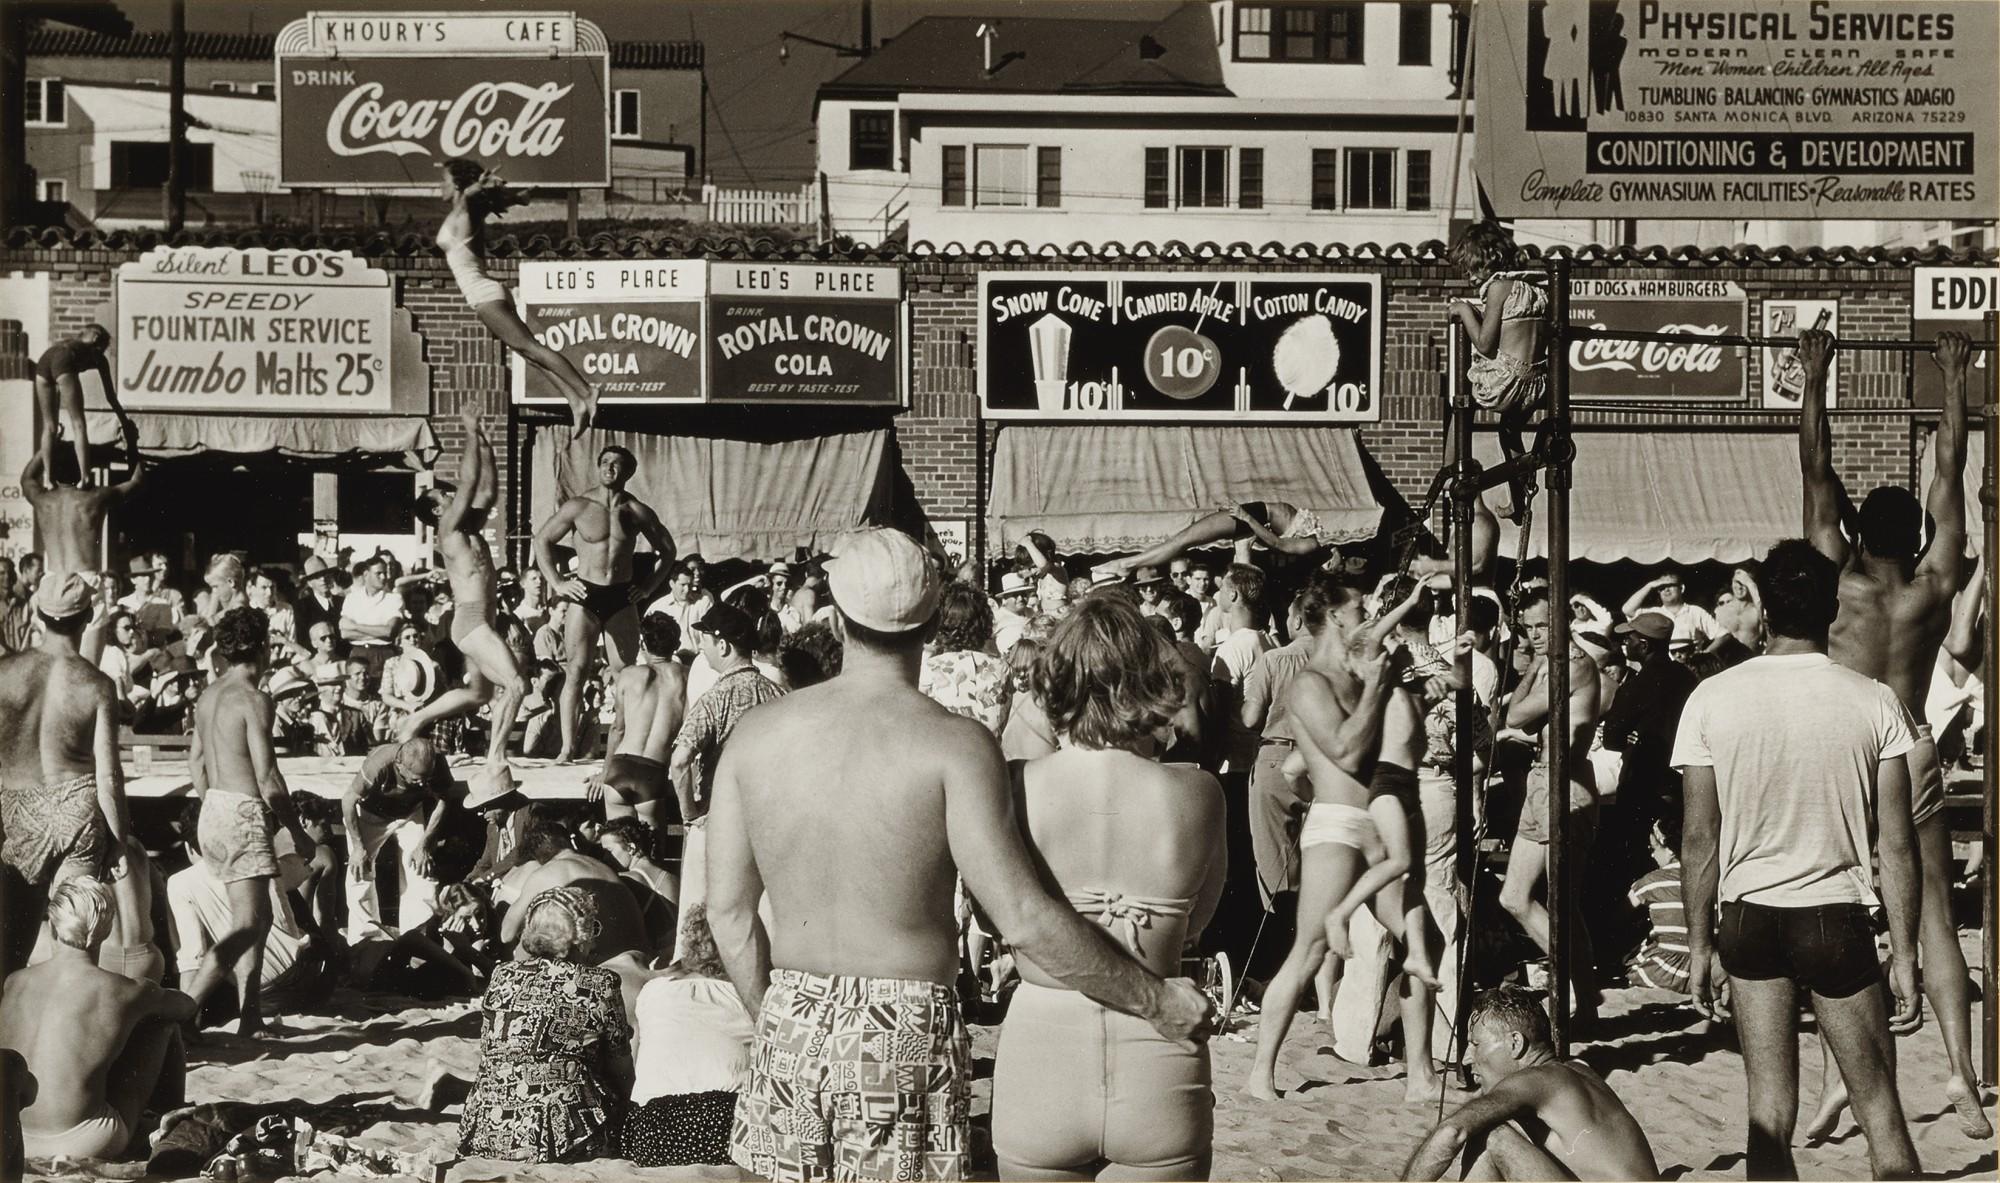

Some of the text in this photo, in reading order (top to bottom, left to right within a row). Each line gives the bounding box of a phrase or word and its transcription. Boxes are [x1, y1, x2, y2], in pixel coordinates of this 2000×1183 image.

[326, 21, 561, 42] KHOURY'S CAFE
[1639, 1, 1955, 41] PHYSICAL SERVICES
[1896, 49, 1955, 59] SAFE
[292, 70, 356, 86] DRINK
[1654, 59, 1935, 84] Men Women Children All Ages
[1638, 87, 1955, 106] TUMBLING BALANCING GYMNASTICS ADAGIO
[326, 81, 575, 157] Coca-Cola
[1625, 111, 1664, 122] 10830
[1674, 111, 1717, 122] SANTA
[1724, 111, 1789, 123] MONICA
[1852, 111, 1915, 123] ARIZONA
[1922, 111, 1966, 123] 75229
[1597, 140, 1965, 170] CONDITIONING & DEVELOPMENT
[1521, 168, 1976, 211] Complete GYMNASIUM FACILITIES Reasonable RATES
[153, 252, 344, 278] Silent LEO'S
[546, 267, 678, 290] LEO'S PLACE
[736, 267, 874, 292] LEO'S PLACE
[1595, 281, 1628, 296] DOGS
[1639, 281, 1728, 297] HAMBURGERS
[184, 292, 315, 311] SPEEDY
[537, 308, 573, 317] DRINK
[726, 308, 765, 317] DRINK
[991, 286, 1105, 323] SNOW CONE
[1124, 288, 1235, 323] CANDIED APPLE
[1253, 287, 1368, 324] COTTON CANDY
[1568, 308, 1596, 320] INK
[131, 316, 372, 344] FOUNTAIN SERVICE
[611, 312, 697, 359] CROWN
[717, 314, 891, 361] ROYAL CROWN
[1568, 323, 1728, 372] CocaCola
[123, 350, 246, 394] Jumbo
[256, 351, 328, 396] Malts
[583, 353, 639, 375] COLA
[775, 354, 833, 376] COLA
[604, 382, 666, 392] TASTE-TEST
[747, 384, 860, 393] BEST BY TASTE-TEST
